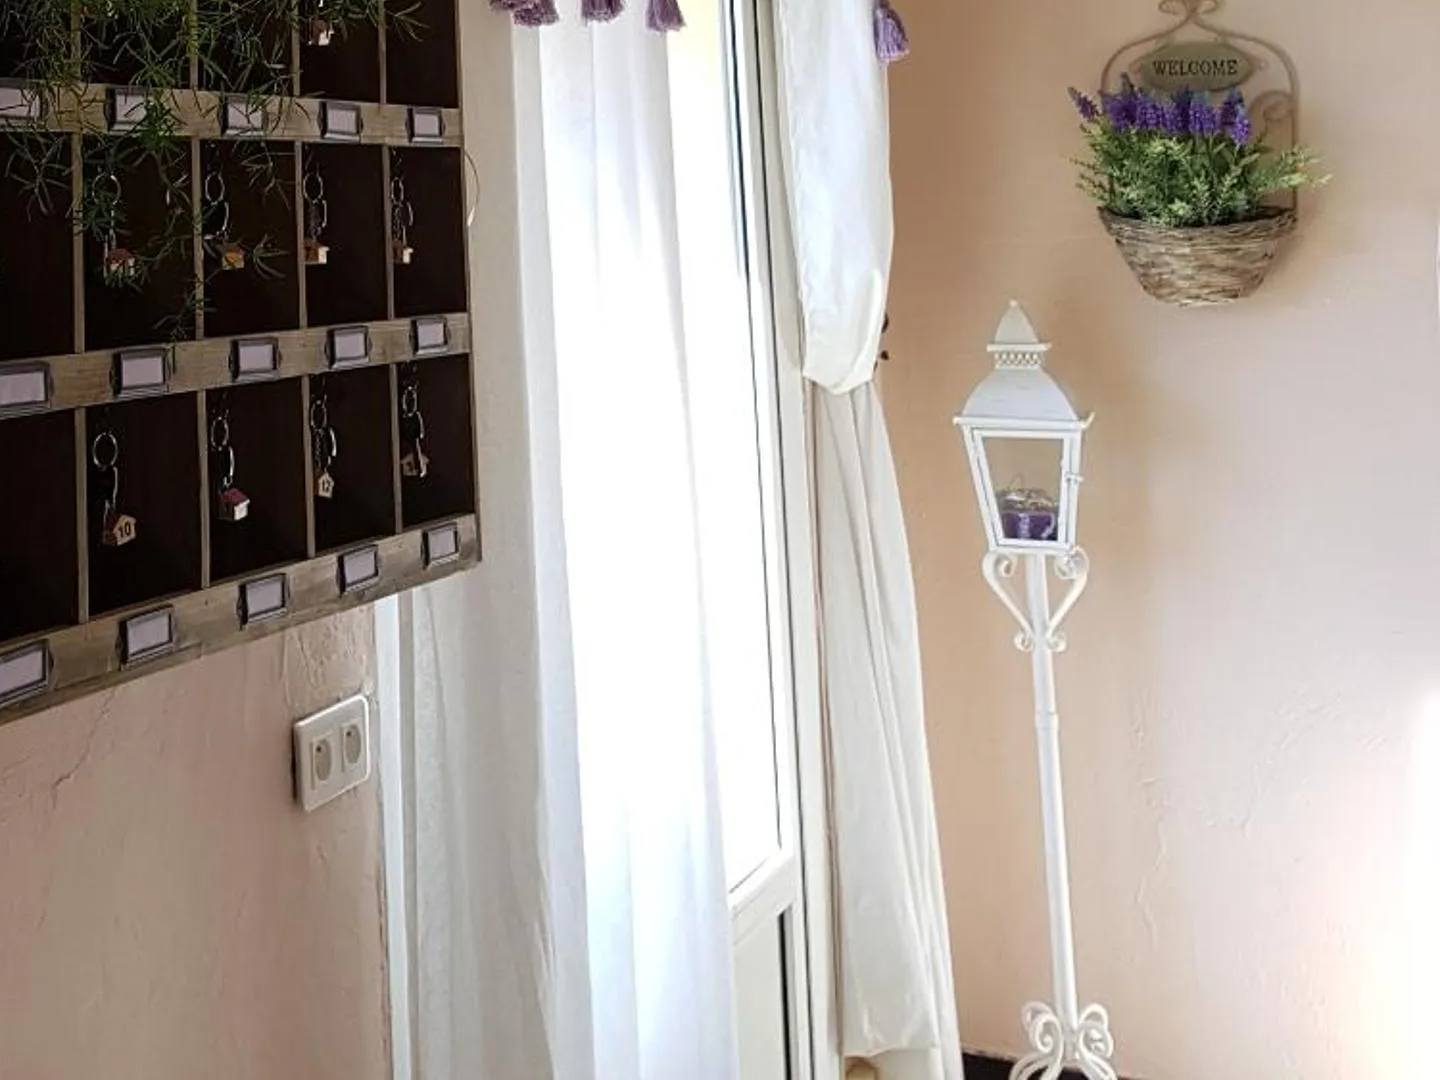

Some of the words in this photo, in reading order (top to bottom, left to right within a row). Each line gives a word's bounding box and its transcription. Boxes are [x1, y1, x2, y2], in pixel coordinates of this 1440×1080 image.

[1152, 59, 1239, 76] WELCOME
[321, 479, 332, 493] 12
[118, 521, 132, 538] 10
